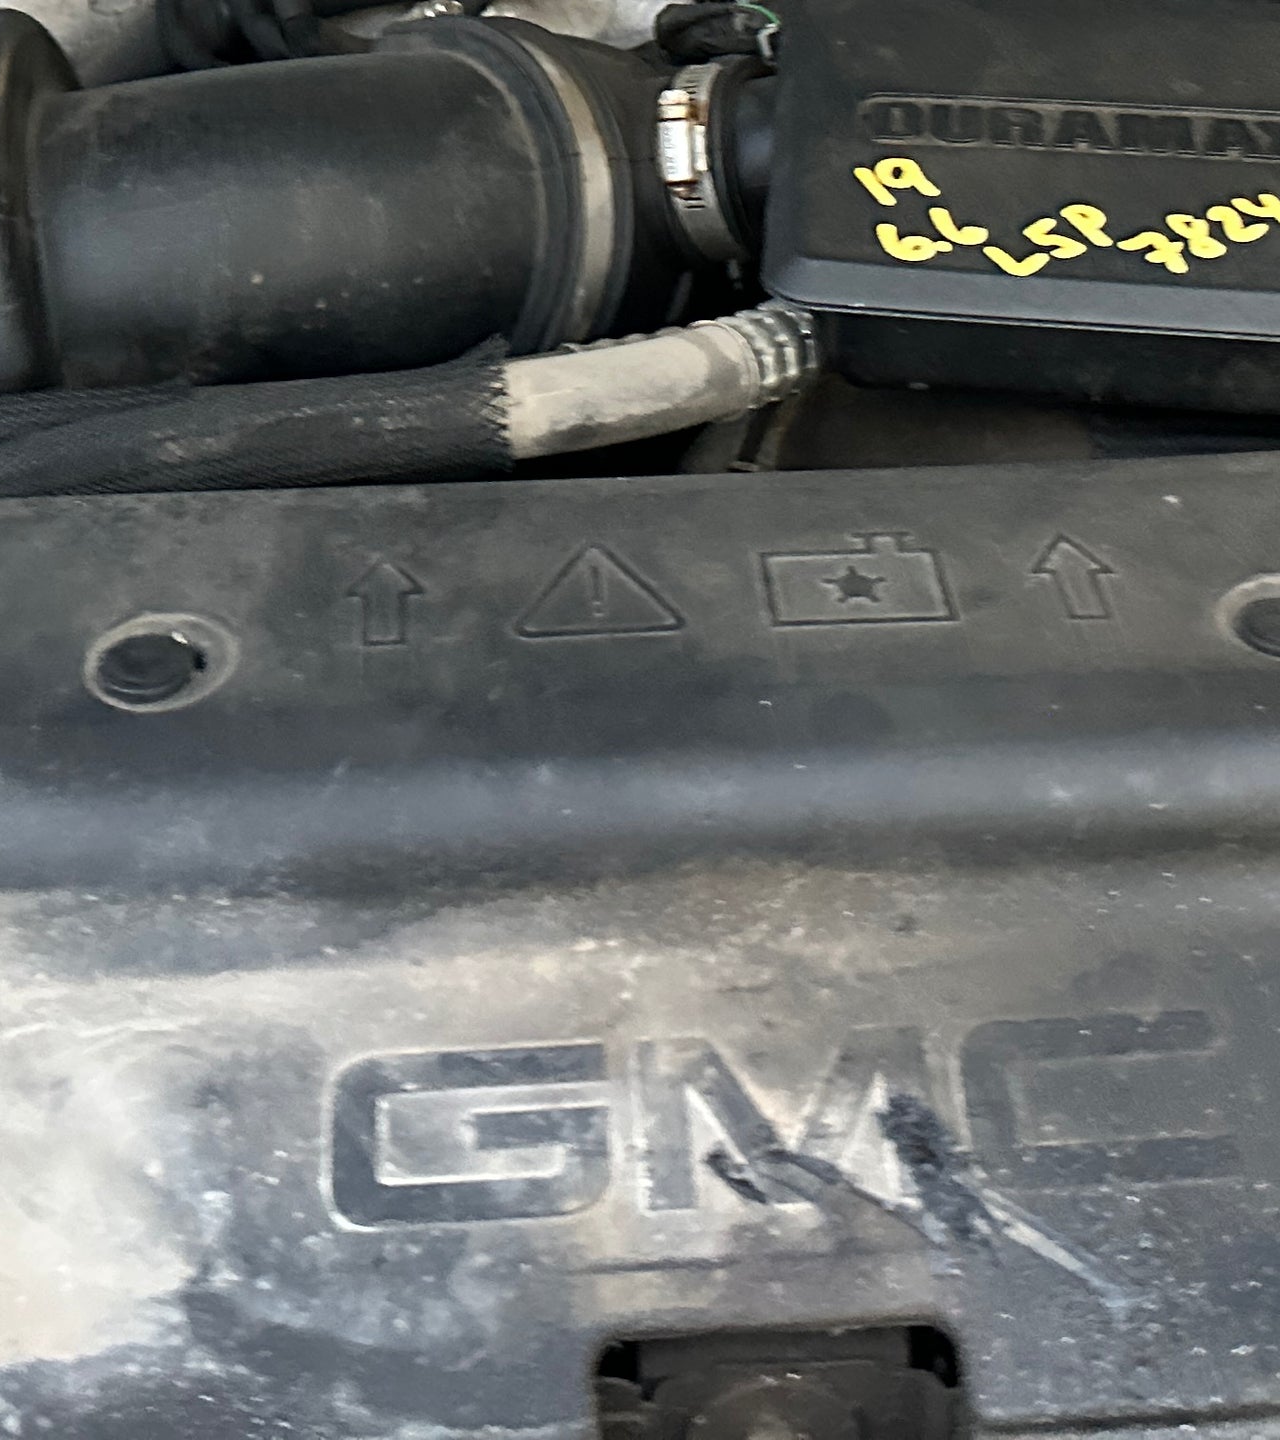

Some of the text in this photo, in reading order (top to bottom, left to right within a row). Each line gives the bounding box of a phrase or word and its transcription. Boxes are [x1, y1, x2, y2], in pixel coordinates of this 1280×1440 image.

[853, 157, 942, 207] 19
[875, 207, 990, 262] 6.6
[322, 1009, 1240, 1234] GMC
